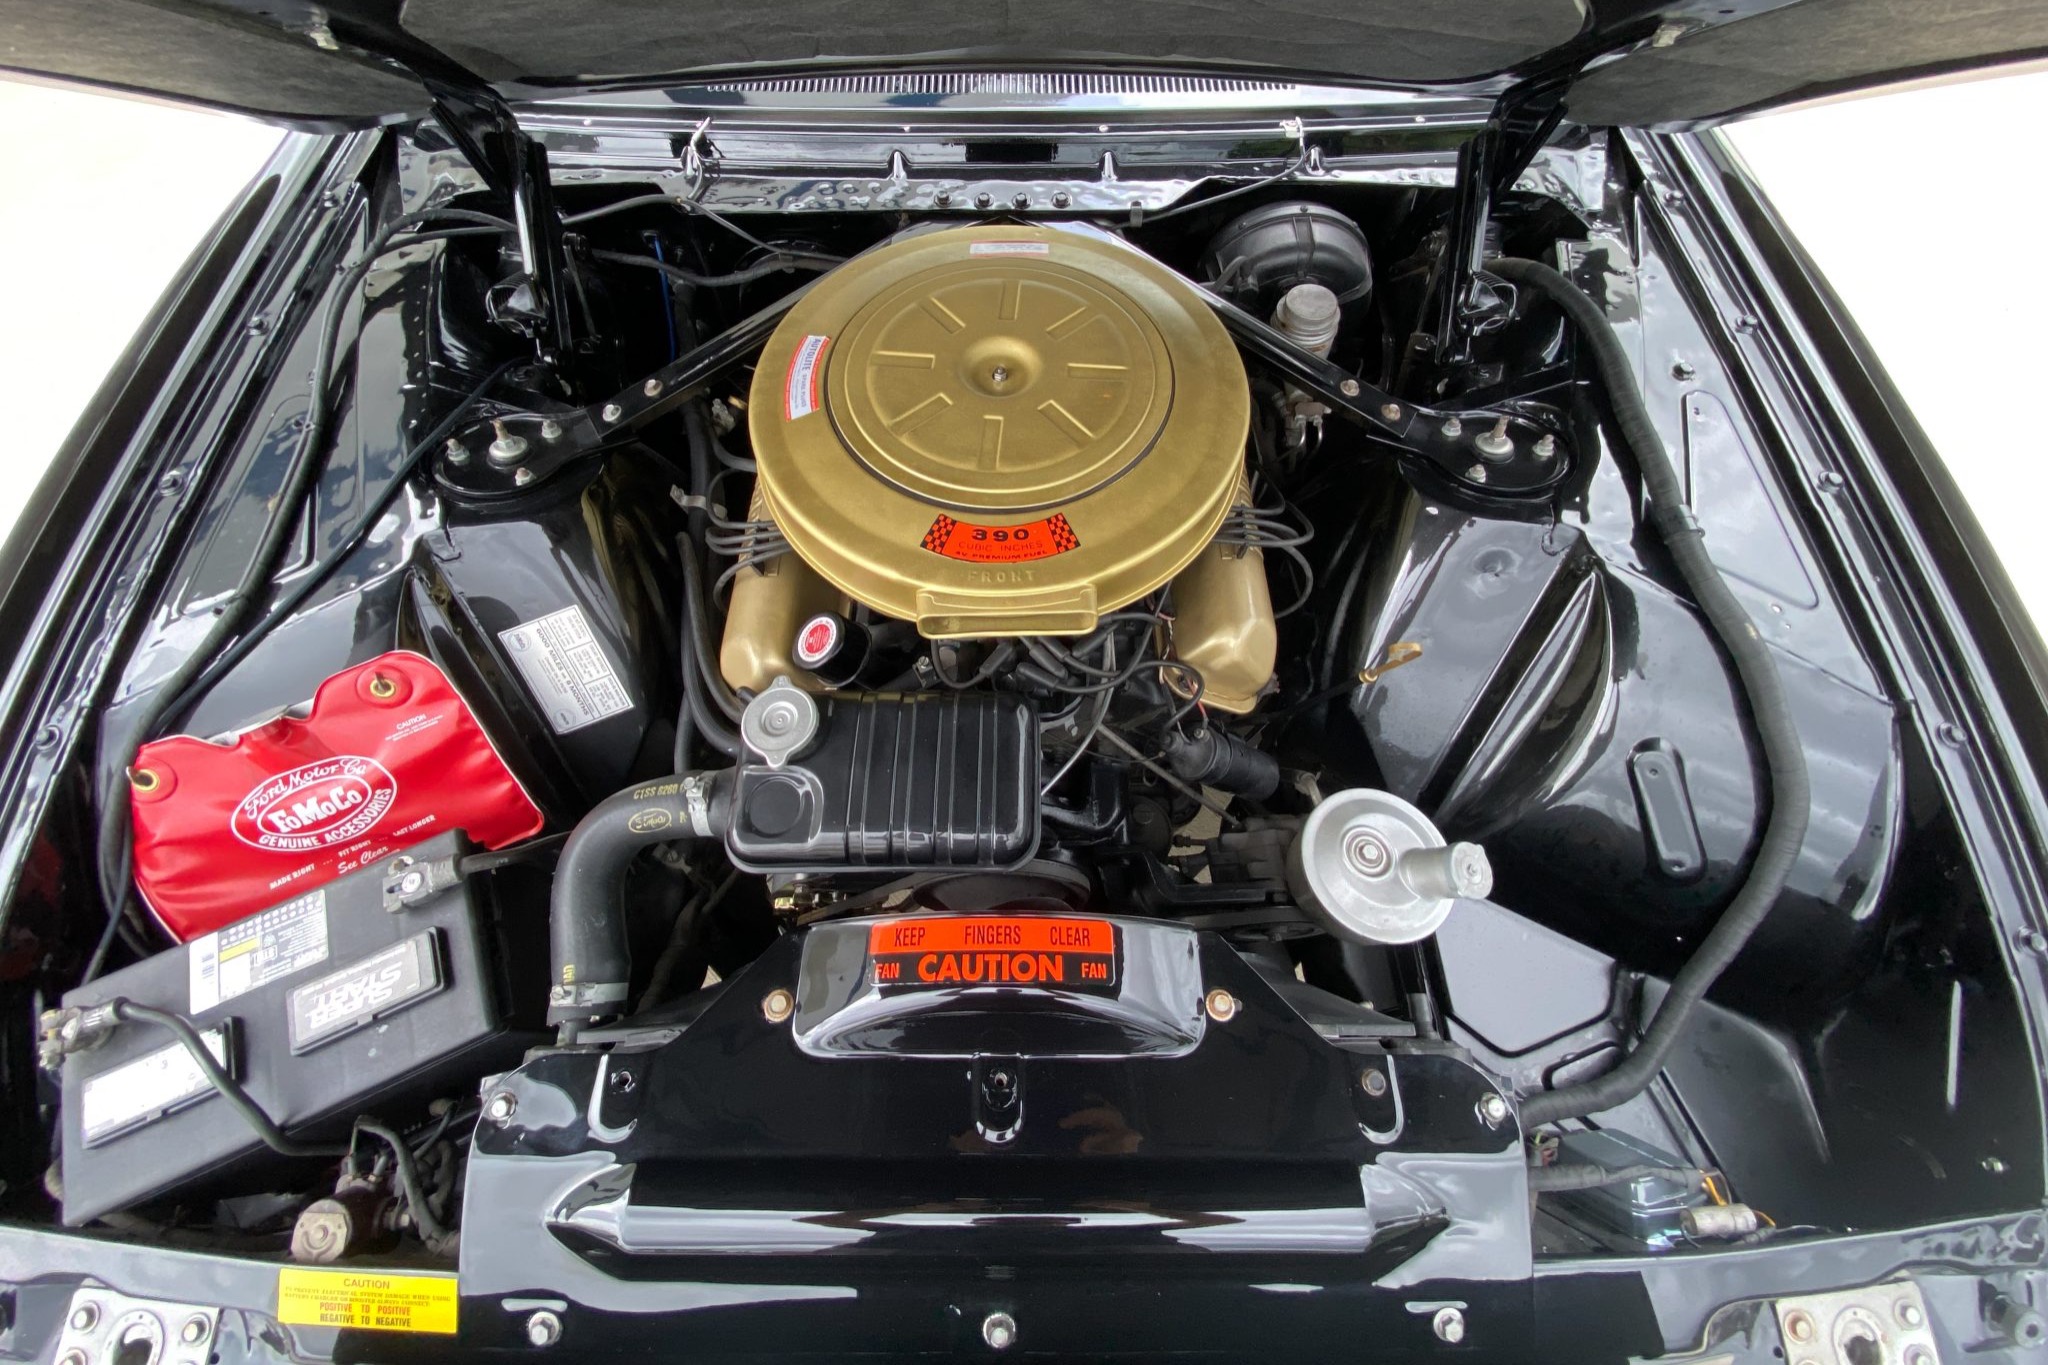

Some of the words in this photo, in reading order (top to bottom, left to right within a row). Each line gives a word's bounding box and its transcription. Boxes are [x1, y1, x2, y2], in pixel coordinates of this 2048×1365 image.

[802, 338, 821, 371] AUTOLITE
[958, 541, 992, 551] CUBIC
[1000, 541, 1043, 551] INCHES
[971, 528, 1029, 542] 390
[1023, 550, 1047, 558] FUEL
[968, 570, 1035, 583] FRONT
[547, 649, 564, 671] MILES
[567, 685, 590, 716] MONTHS
[396, 713, 427, 730] CAUTION
[244, 779, 288, 820] Ford
[288, 765, 339, 792] Motor
[258, 834, 322, 849] GENUINE
[324, 788, 392, 843] ACCESSORIES
[267, 786, 363, 833] FoMoCo
[269, 876, 292, 890] MADE
[292, 863, 316, 880] RIGHT
[338, 849, 350, 858] FIT
[351, 840, 372, 852] RIGHT
[393, 827, 408, 837] LAST
[409, 814, 436, 830] LONGER
[338, 861, 358, 874] See
[360, 846, 388, 864] Clear
[895, 927, 926, 947] KEEP
[965, 925, 1021, 945] FINGERS
[1050, 926, 1090, 946] CLEAR
[875, 963, 899, 979] FAN
[917, 953, 1063, 982] CAUTION
[1081, 962, 1107, 979] FAN
[309, 961, 402, 1008] START
[343, 1278, 390, 1290] CAUTION
[319, 1302, 352, 1313] POSITIVE
[361, 1304, 370, 1313] TO
[377, 1305, 411, 1316] POSITIVE
[320, 1313, 355, 1324] NEGATIVE
[361, 1315, 370, 1325] TO
[376, 1315, 411, 1327] NEGATIVE
